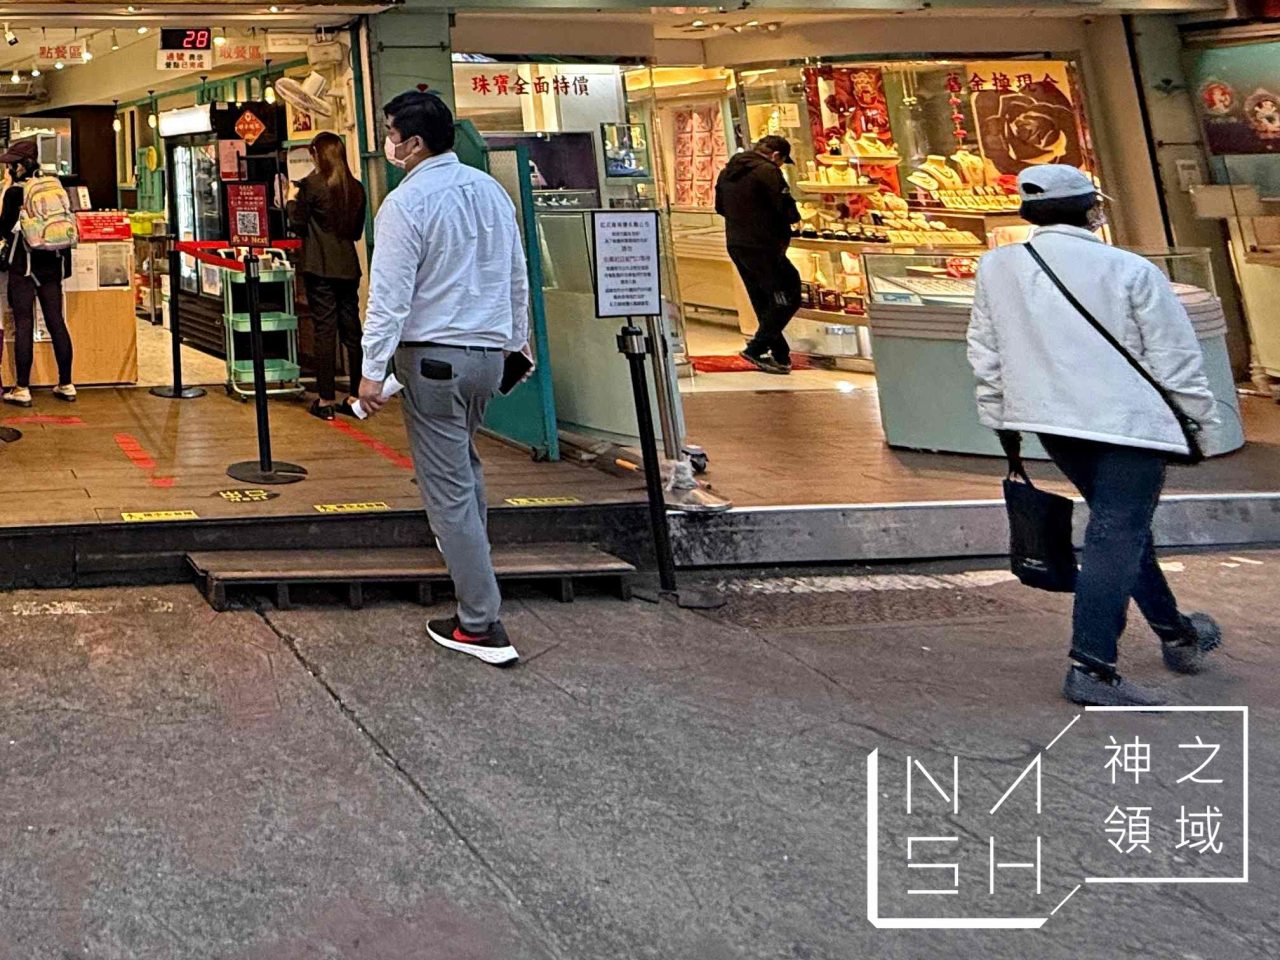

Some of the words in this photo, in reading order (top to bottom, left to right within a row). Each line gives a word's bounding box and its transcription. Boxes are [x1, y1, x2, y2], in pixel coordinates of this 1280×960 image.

[182, 31, 208, 48] 28
[38, 45, 83, 60] 點餐區
[471, 74, 590, 96] 珠寶全面特價
